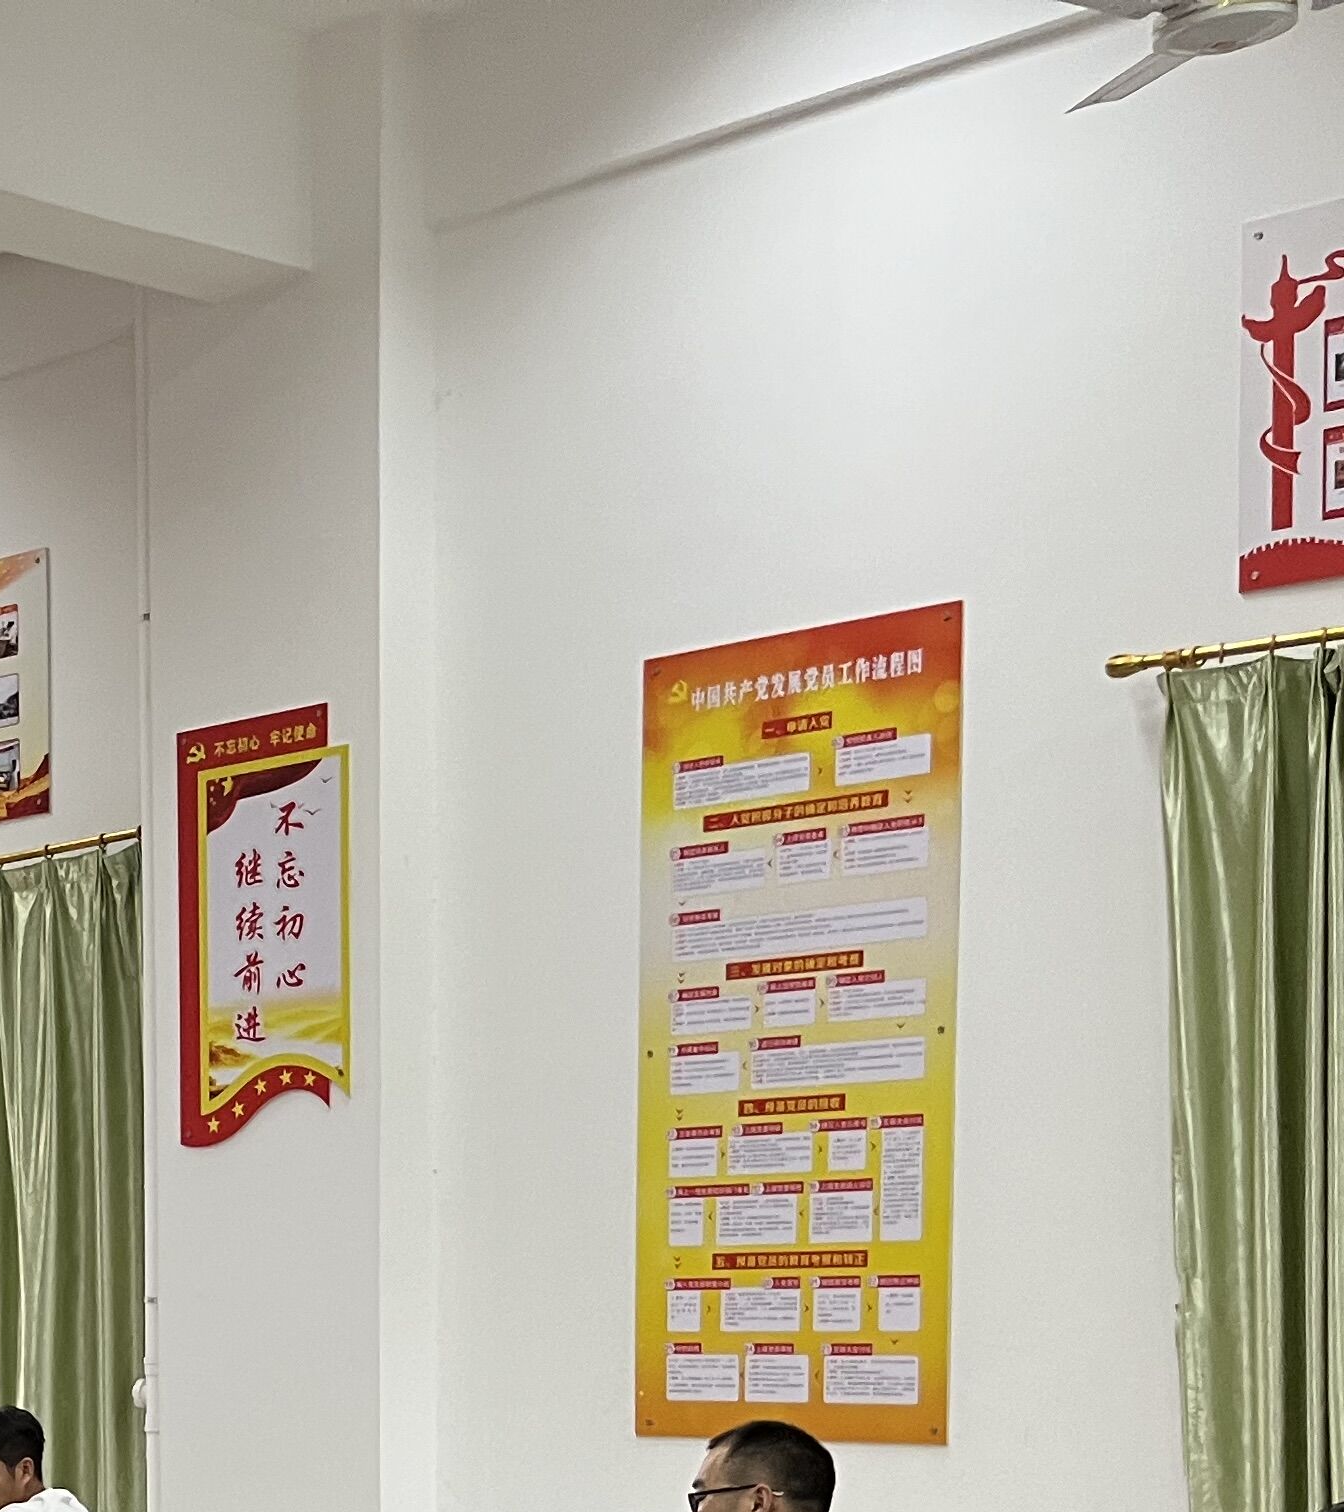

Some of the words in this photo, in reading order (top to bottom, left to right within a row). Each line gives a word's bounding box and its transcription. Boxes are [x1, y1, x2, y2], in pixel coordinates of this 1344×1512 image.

[214, 735, 261, 758] 不忘初心
[269, 722, 317, 747] 牢记使命
[691, 647, 924, 711] 中国共产党发展党员工作流程图
[233, 850, 267, 1043] 继续前进
[273, 800, 305, 990] 不忘初心
